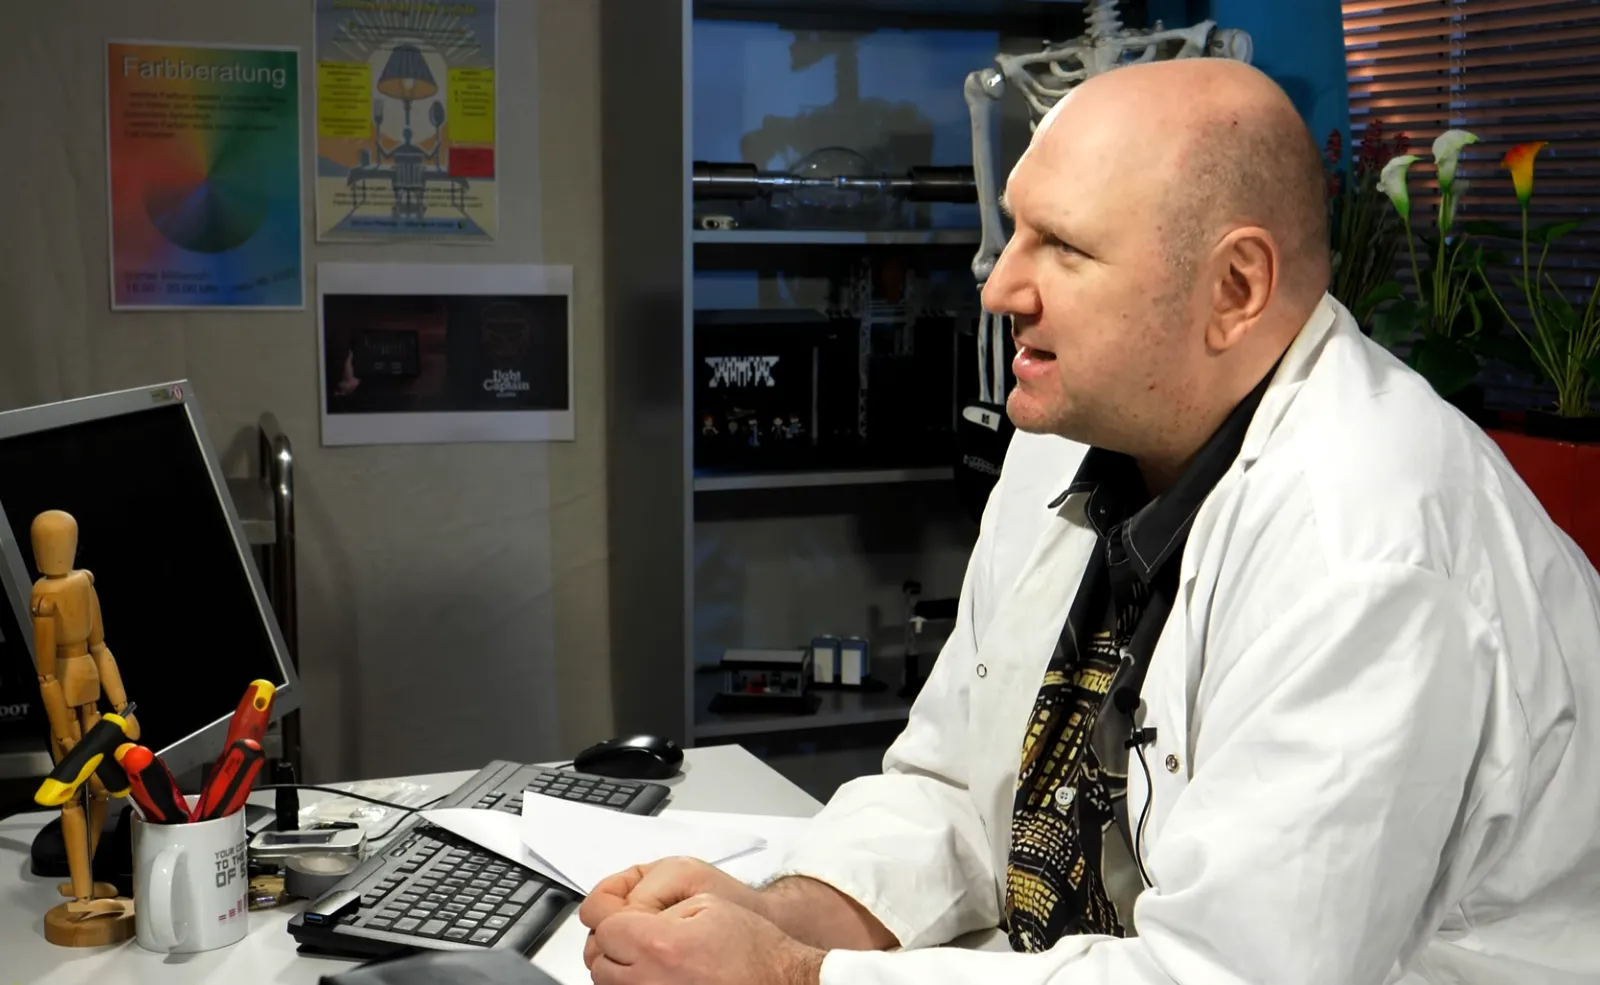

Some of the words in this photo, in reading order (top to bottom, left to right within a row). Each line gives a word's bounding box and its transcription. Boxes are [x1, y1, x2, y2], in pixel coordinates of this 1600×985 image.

[122, 55, 287, 90] Farbberatung
[492, 369, 521, 384] Light
[483, 379, 530, 392] Captain
[215, 859, 229, 871] TO
[216, 867, 236, 888] OF
